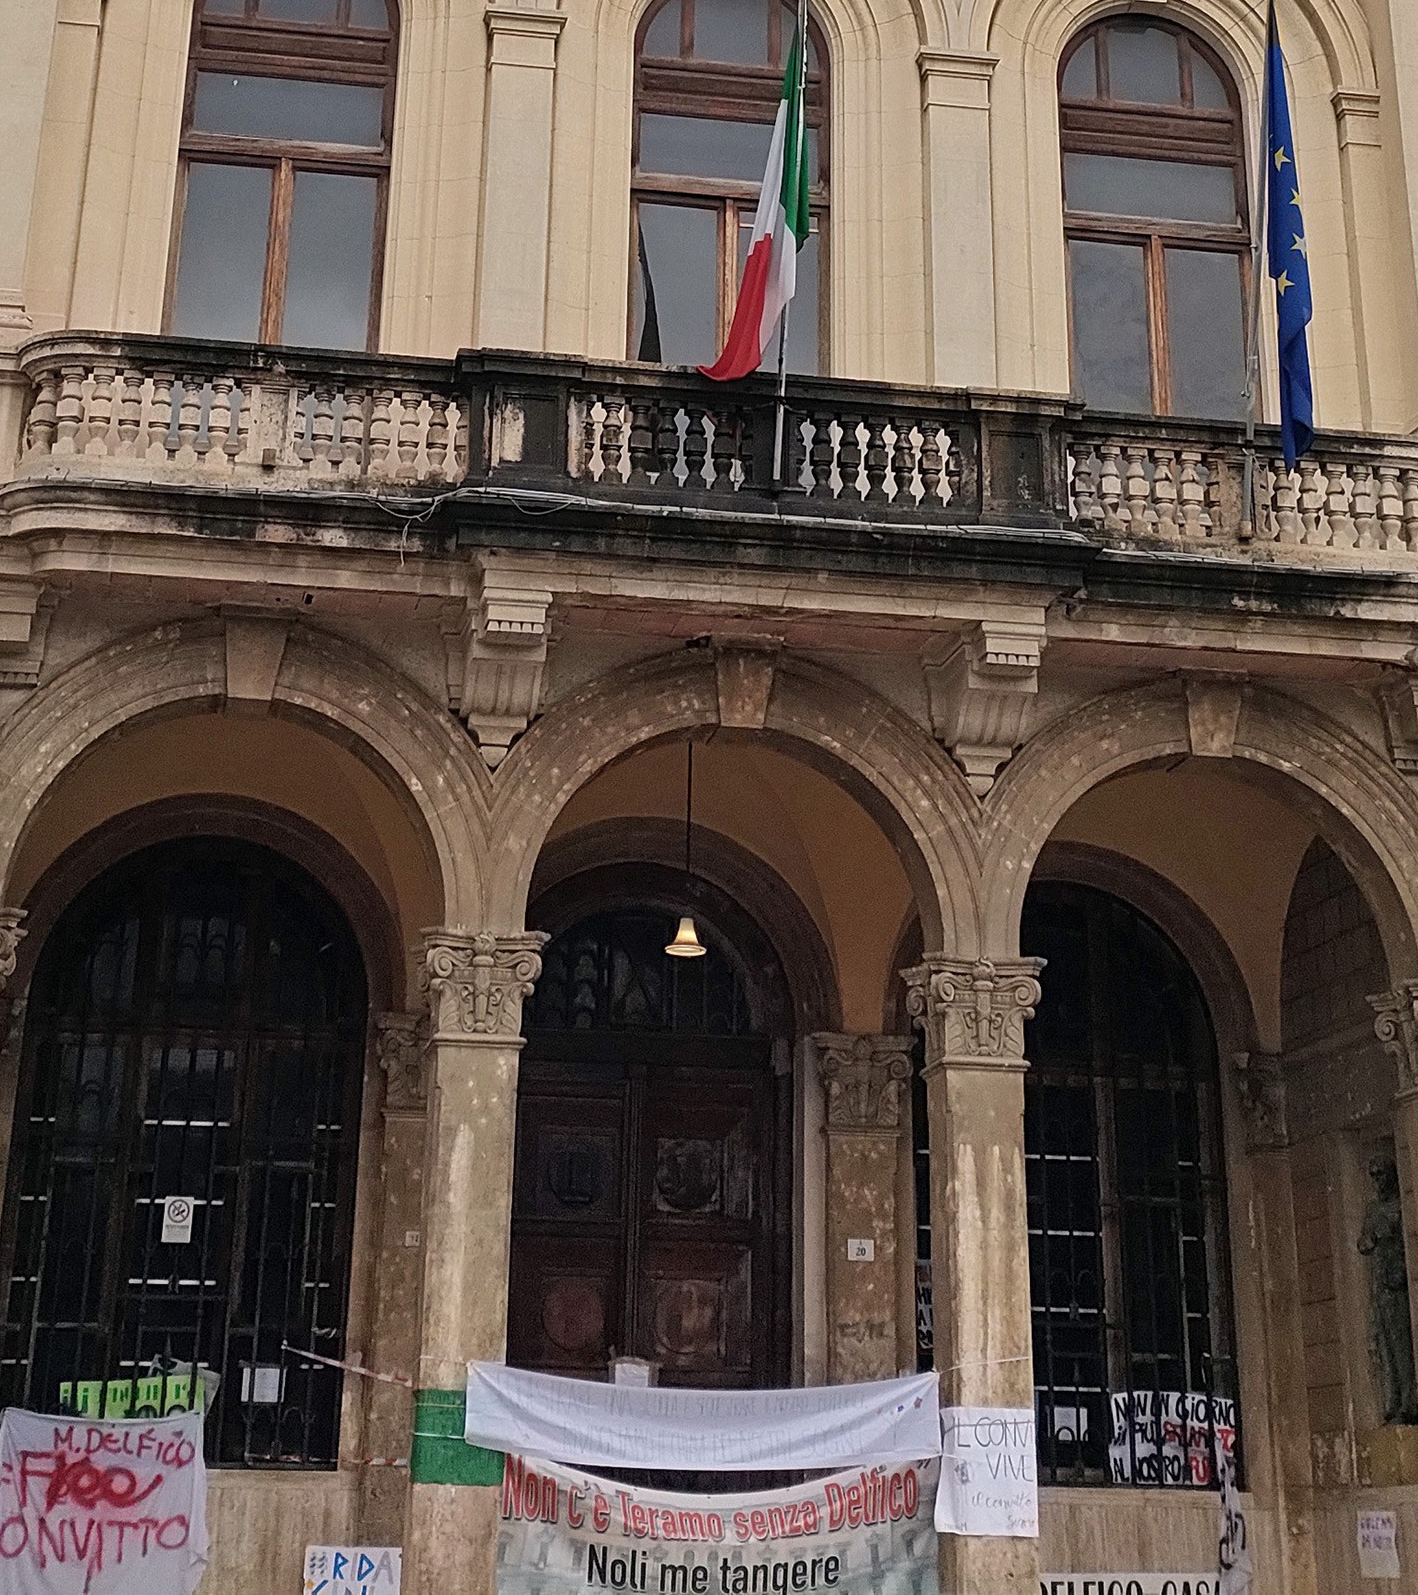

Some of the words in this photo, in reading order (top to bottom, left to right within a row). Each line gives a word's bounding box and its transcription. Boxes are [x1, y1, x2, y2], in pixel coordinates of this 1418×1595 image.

[855, 1246, 867, 1257] 20
[502, 1452, 559, 1524] Non
[567, 1480, 611, 1533] c'è
[616, 1489, 724, 1542] Teramo
[733, 1500, 820, 1542] senza
[586, 1543, 648, 1591] Noli
[659, 1563, 710, 1594] me
[719, 1555, 841, 1595] tangere
